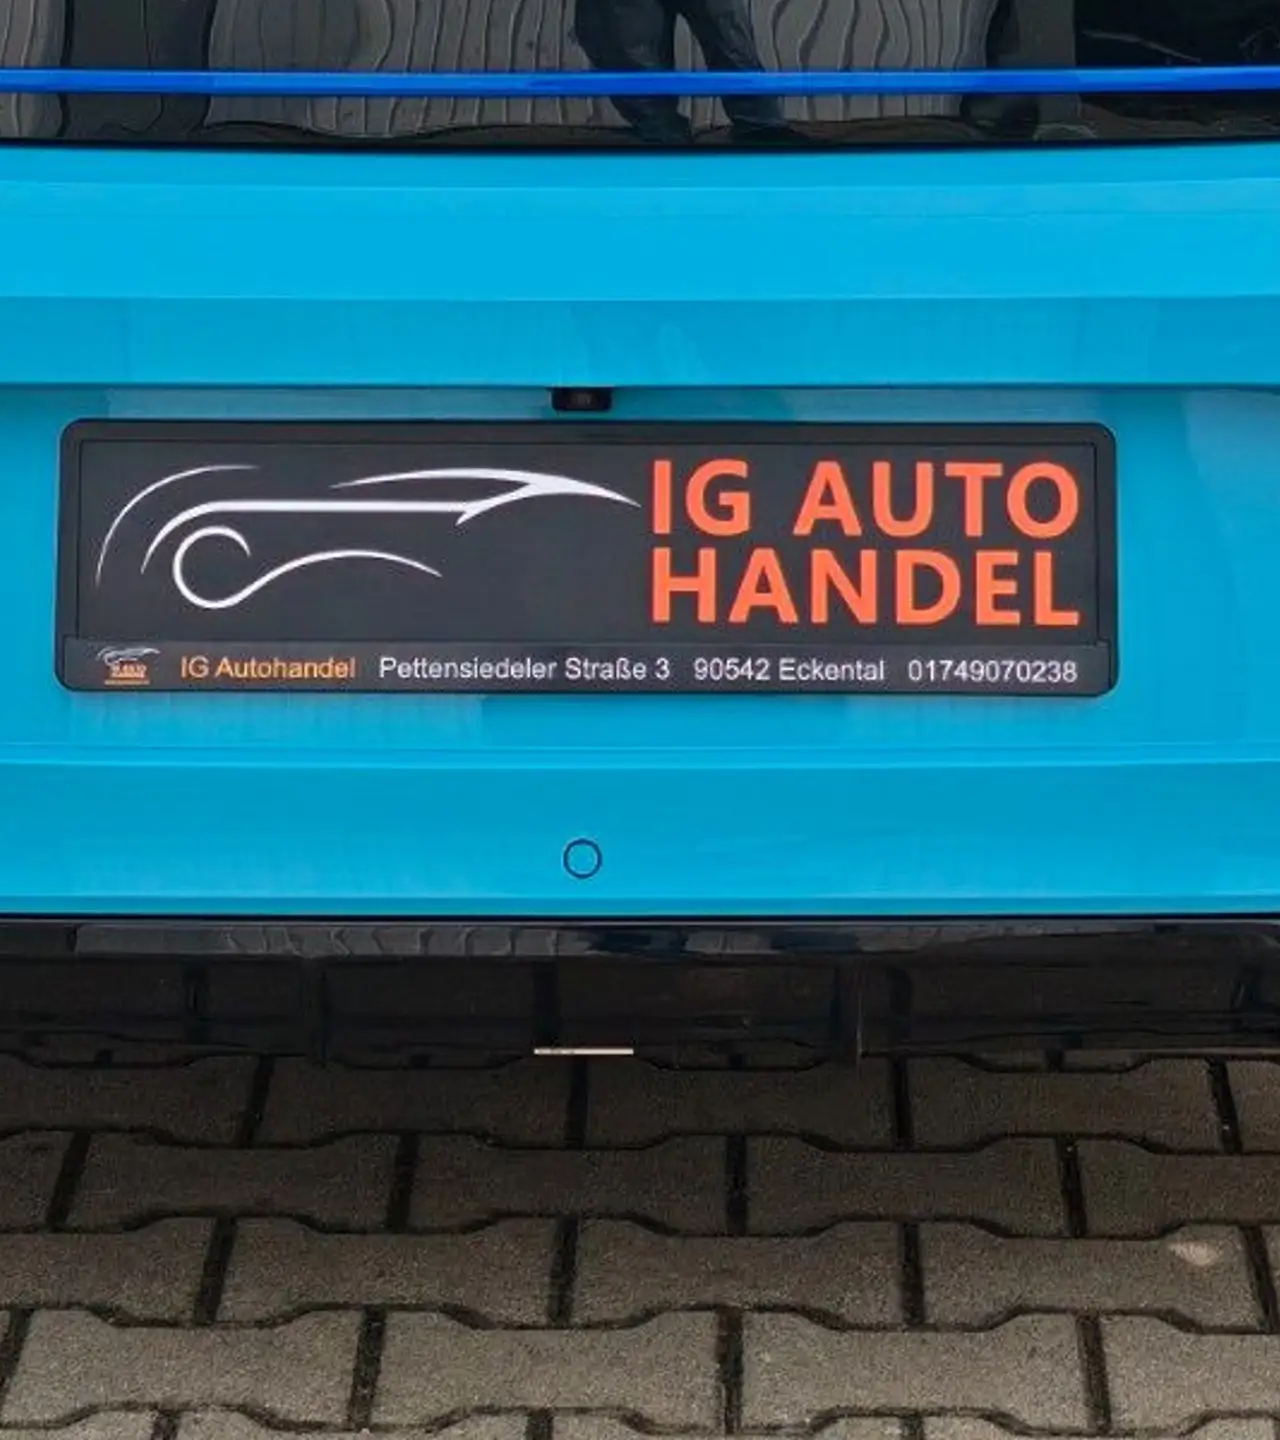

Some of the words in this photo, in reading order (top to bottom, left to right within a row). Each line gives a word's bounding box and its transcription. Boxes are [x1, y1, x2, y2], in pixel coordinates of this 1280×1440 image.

[652, 459, 751, 537] IG
[793, 460, 1080, 540] AUTO
[652, 546, 1081, 626] HANDEL
[180, 656, 210, 679] IG
[215, 656, 357, 679] Autohandel
[378, 656, 557, 681] Pettensiedeler
[564, 656, 647, 681] Straße
[653, 658, 671, 681] 3
[693, 658, 771, 681] 90542
[778, 658, 886, 682] Eckental
[907, 659, 1079, 683] 01749070238
